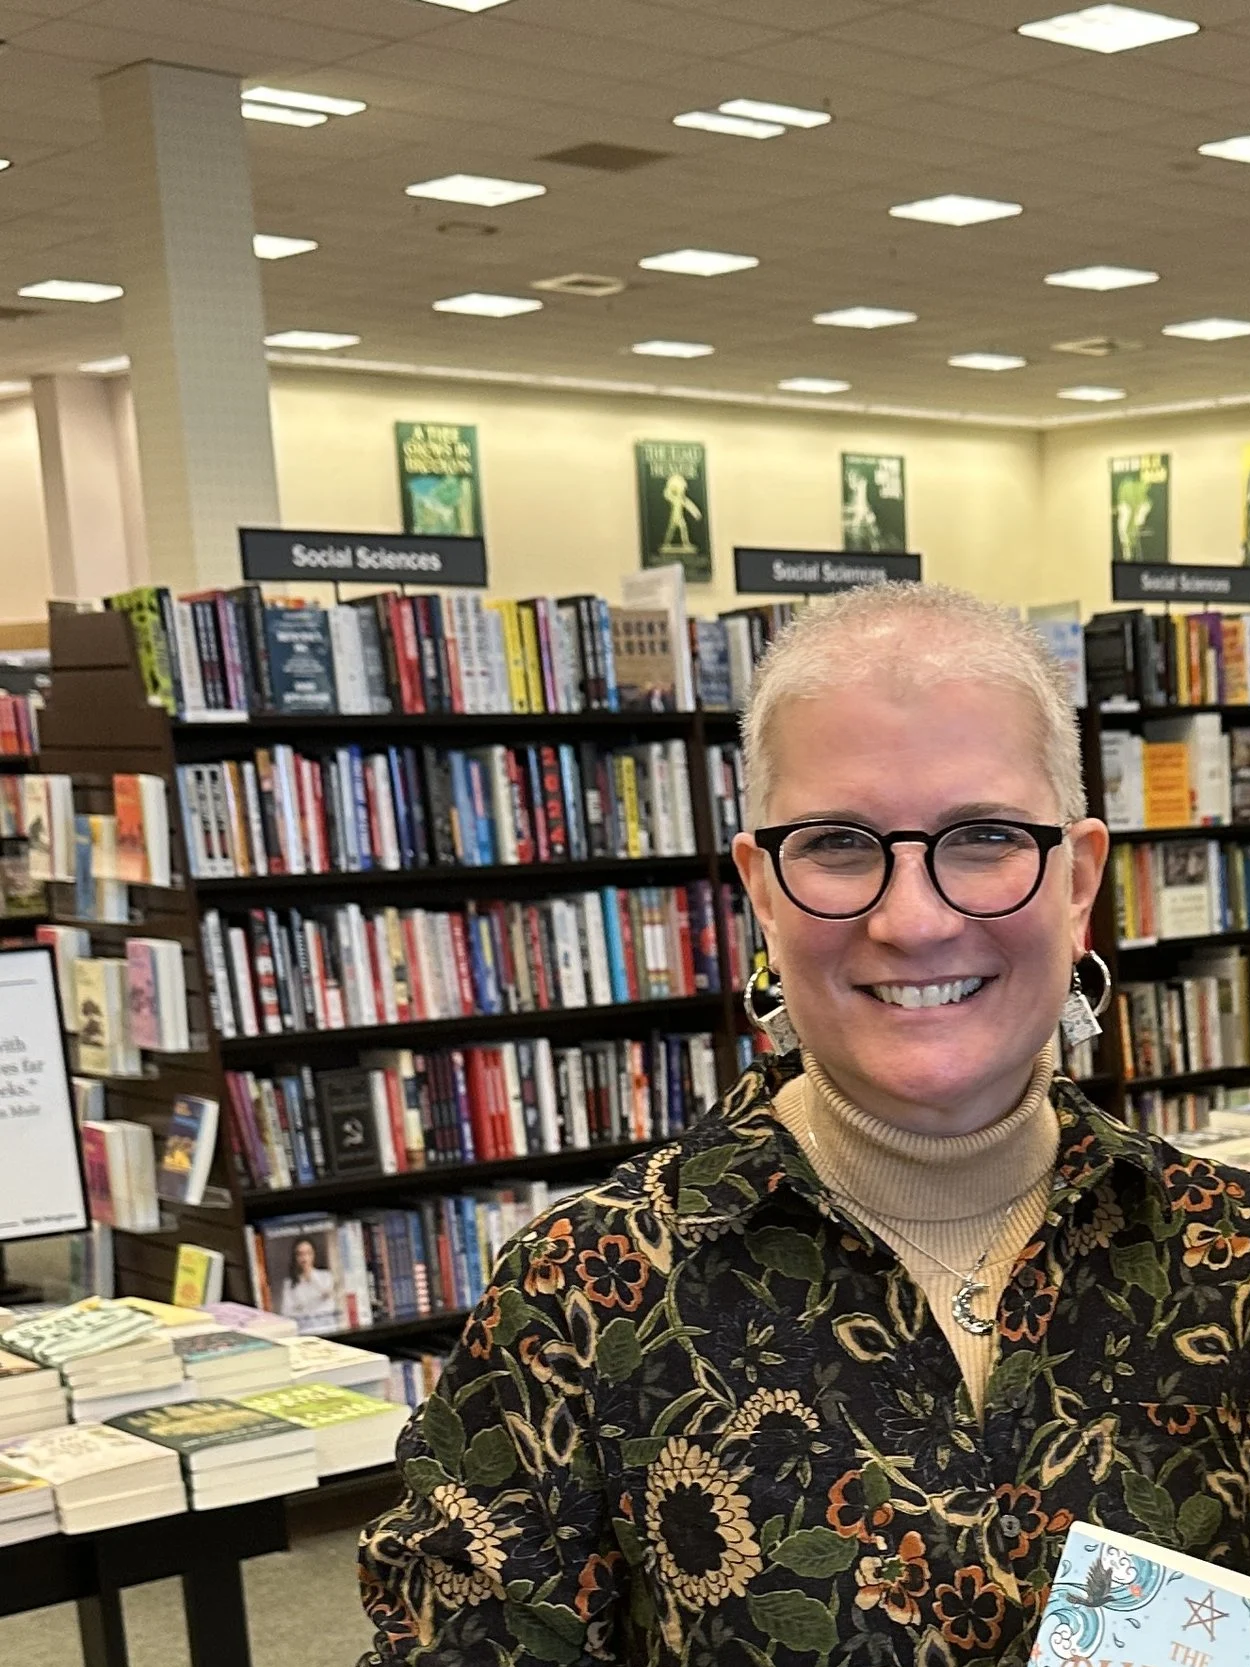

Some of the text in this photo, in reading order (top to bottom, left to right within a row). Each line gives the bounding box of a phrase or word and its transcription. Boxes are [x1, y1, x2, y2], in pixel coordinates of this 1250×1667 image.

[292, 543, 443, 572] Social Sciences
[772, 558, 889, 583] Social Sciences
